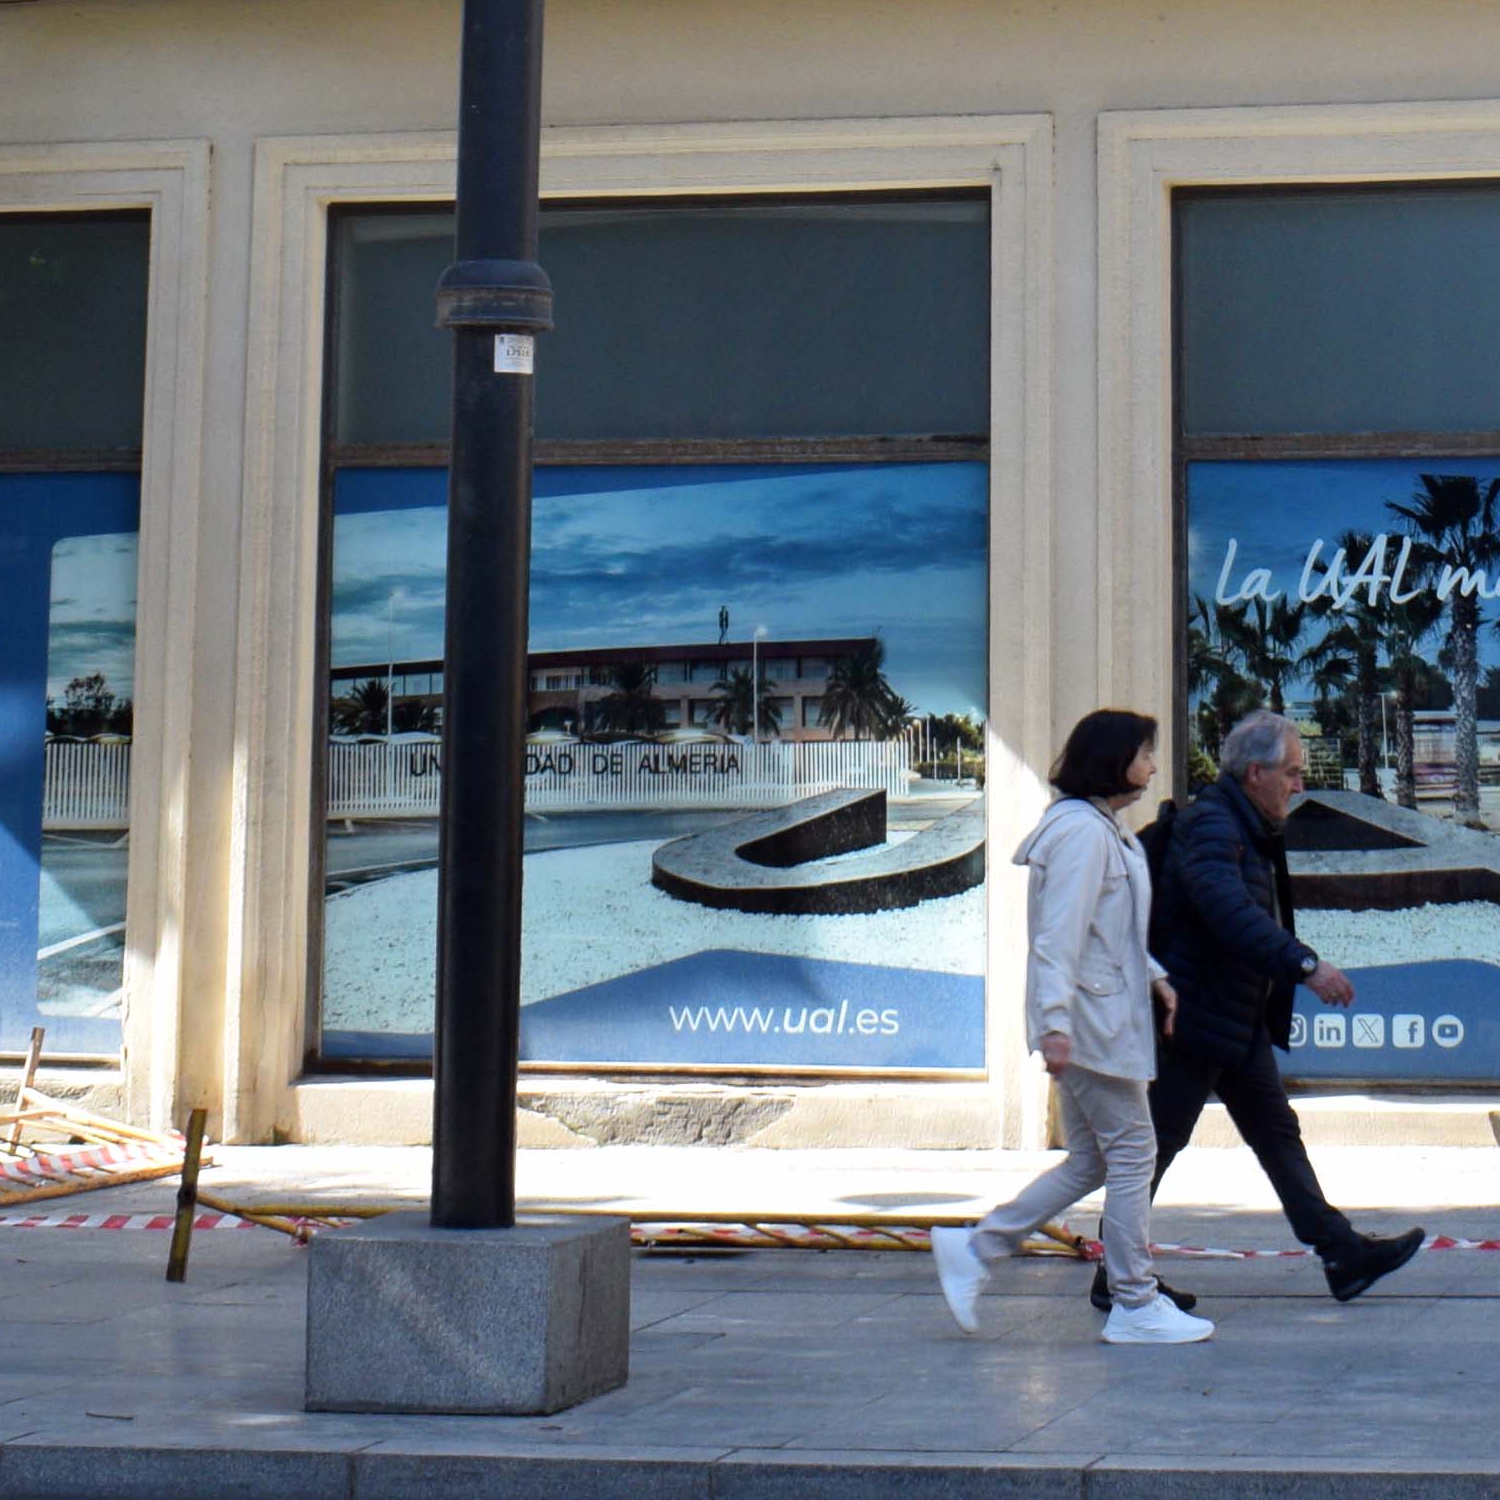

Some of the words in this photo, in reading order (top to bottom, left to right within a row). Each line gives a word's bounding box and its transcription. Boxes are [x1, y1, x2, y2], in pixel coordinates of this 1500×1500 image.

[1299, 533, 1431, 610] UAL
[593, 752, 623, 775] DE
[668, 998, 901, 1035] www.ual.es
